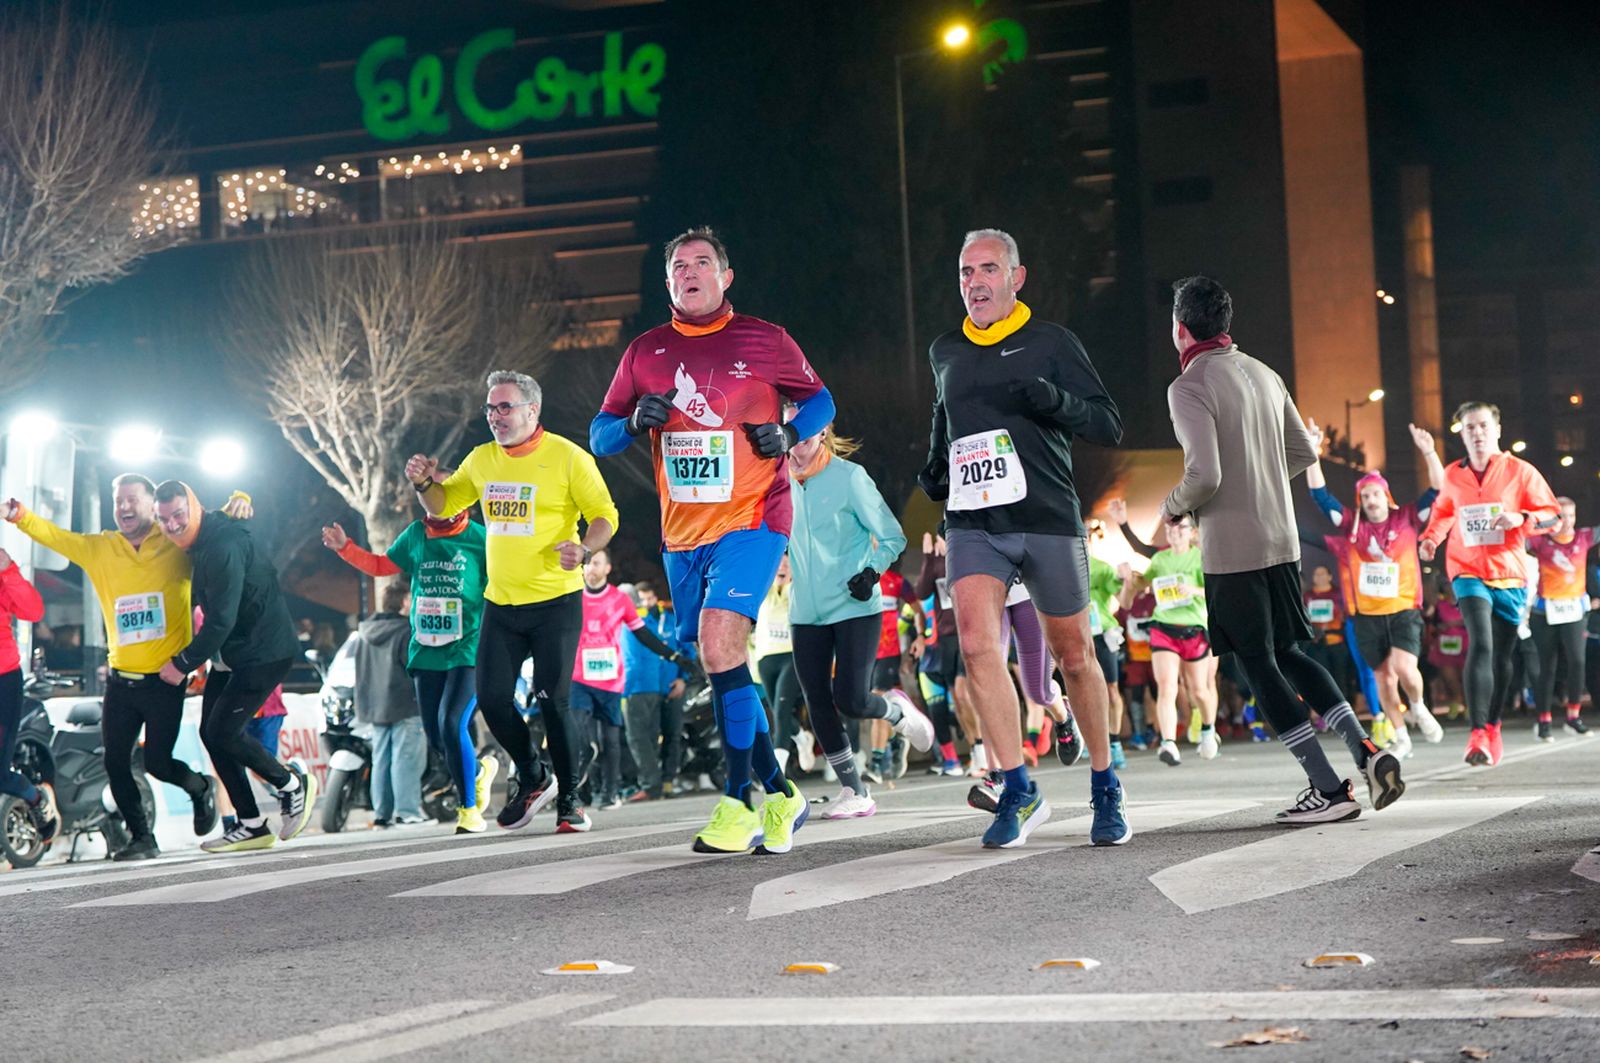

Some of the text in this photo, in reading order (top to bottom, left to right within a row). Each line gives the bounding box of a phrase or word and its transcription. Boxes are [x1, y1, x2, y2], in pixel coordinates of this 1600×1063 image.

[354, 27, 667, 141] El Corte
[686, 399, 706, 417] 43
[672, 439, 703, 447] NOCHE DE
[668, 448, 679, 456] SAN
[672, 457, 720, 478] 13721
[960, 457, 1008, 486] 2029
[487, 501, 528, 517] 13820
[1366, 575, 1392, 585] 6059
[121, 611, 154, 628] 3874
[420, 615, 452, 630] 6336
[279, 728, 319, 760] SAN
